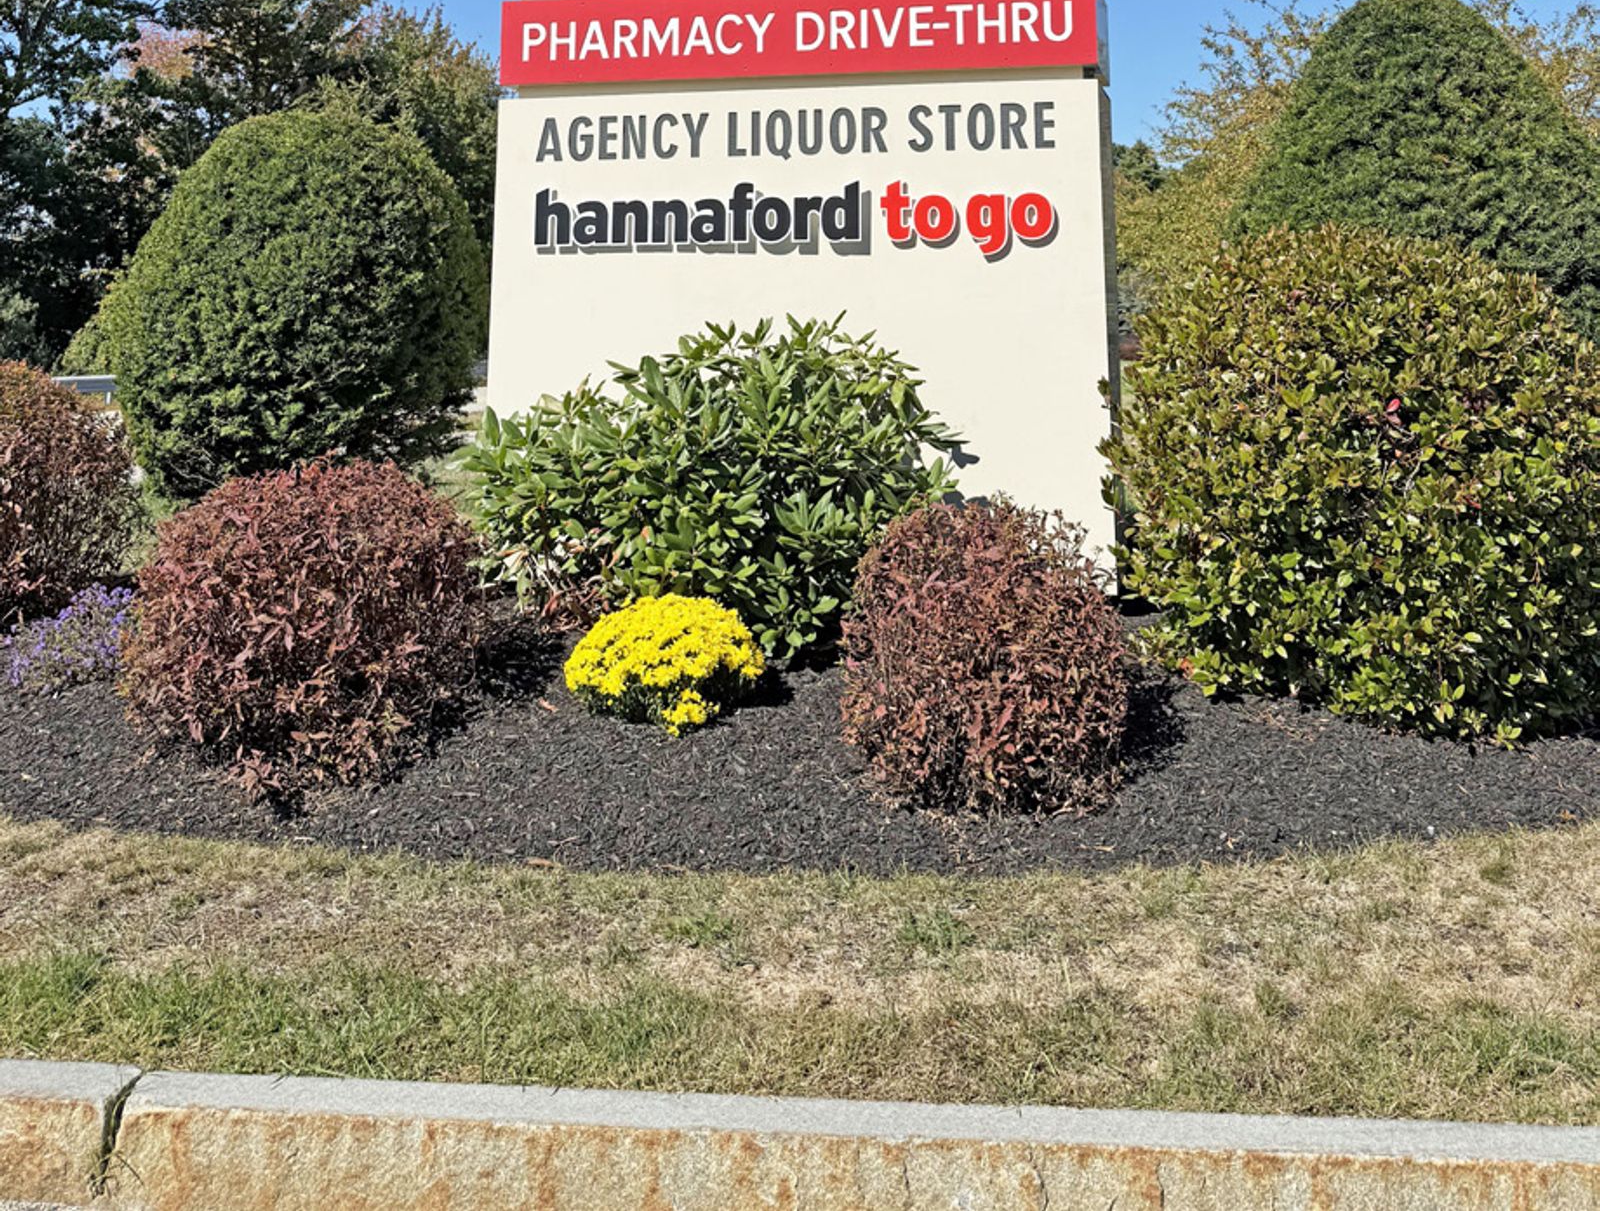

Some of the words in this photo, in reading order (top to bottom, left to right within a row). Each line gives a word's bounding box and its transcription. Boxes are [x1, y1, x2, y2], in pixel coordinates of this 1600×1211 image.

[521, 12, 776, 62] PHARMACY
[795, 0, 1074, 52] DRIVE-THRU
[535, 113, 709, 163] AGENCY
[726, 106, 889, 161] LIQUOR
[907, 101, 1056, 153] STORE
[534, 180, 862, 248] hannaford
[880, 180, 955, 242] to
[965, 190, 1056, 258] go
